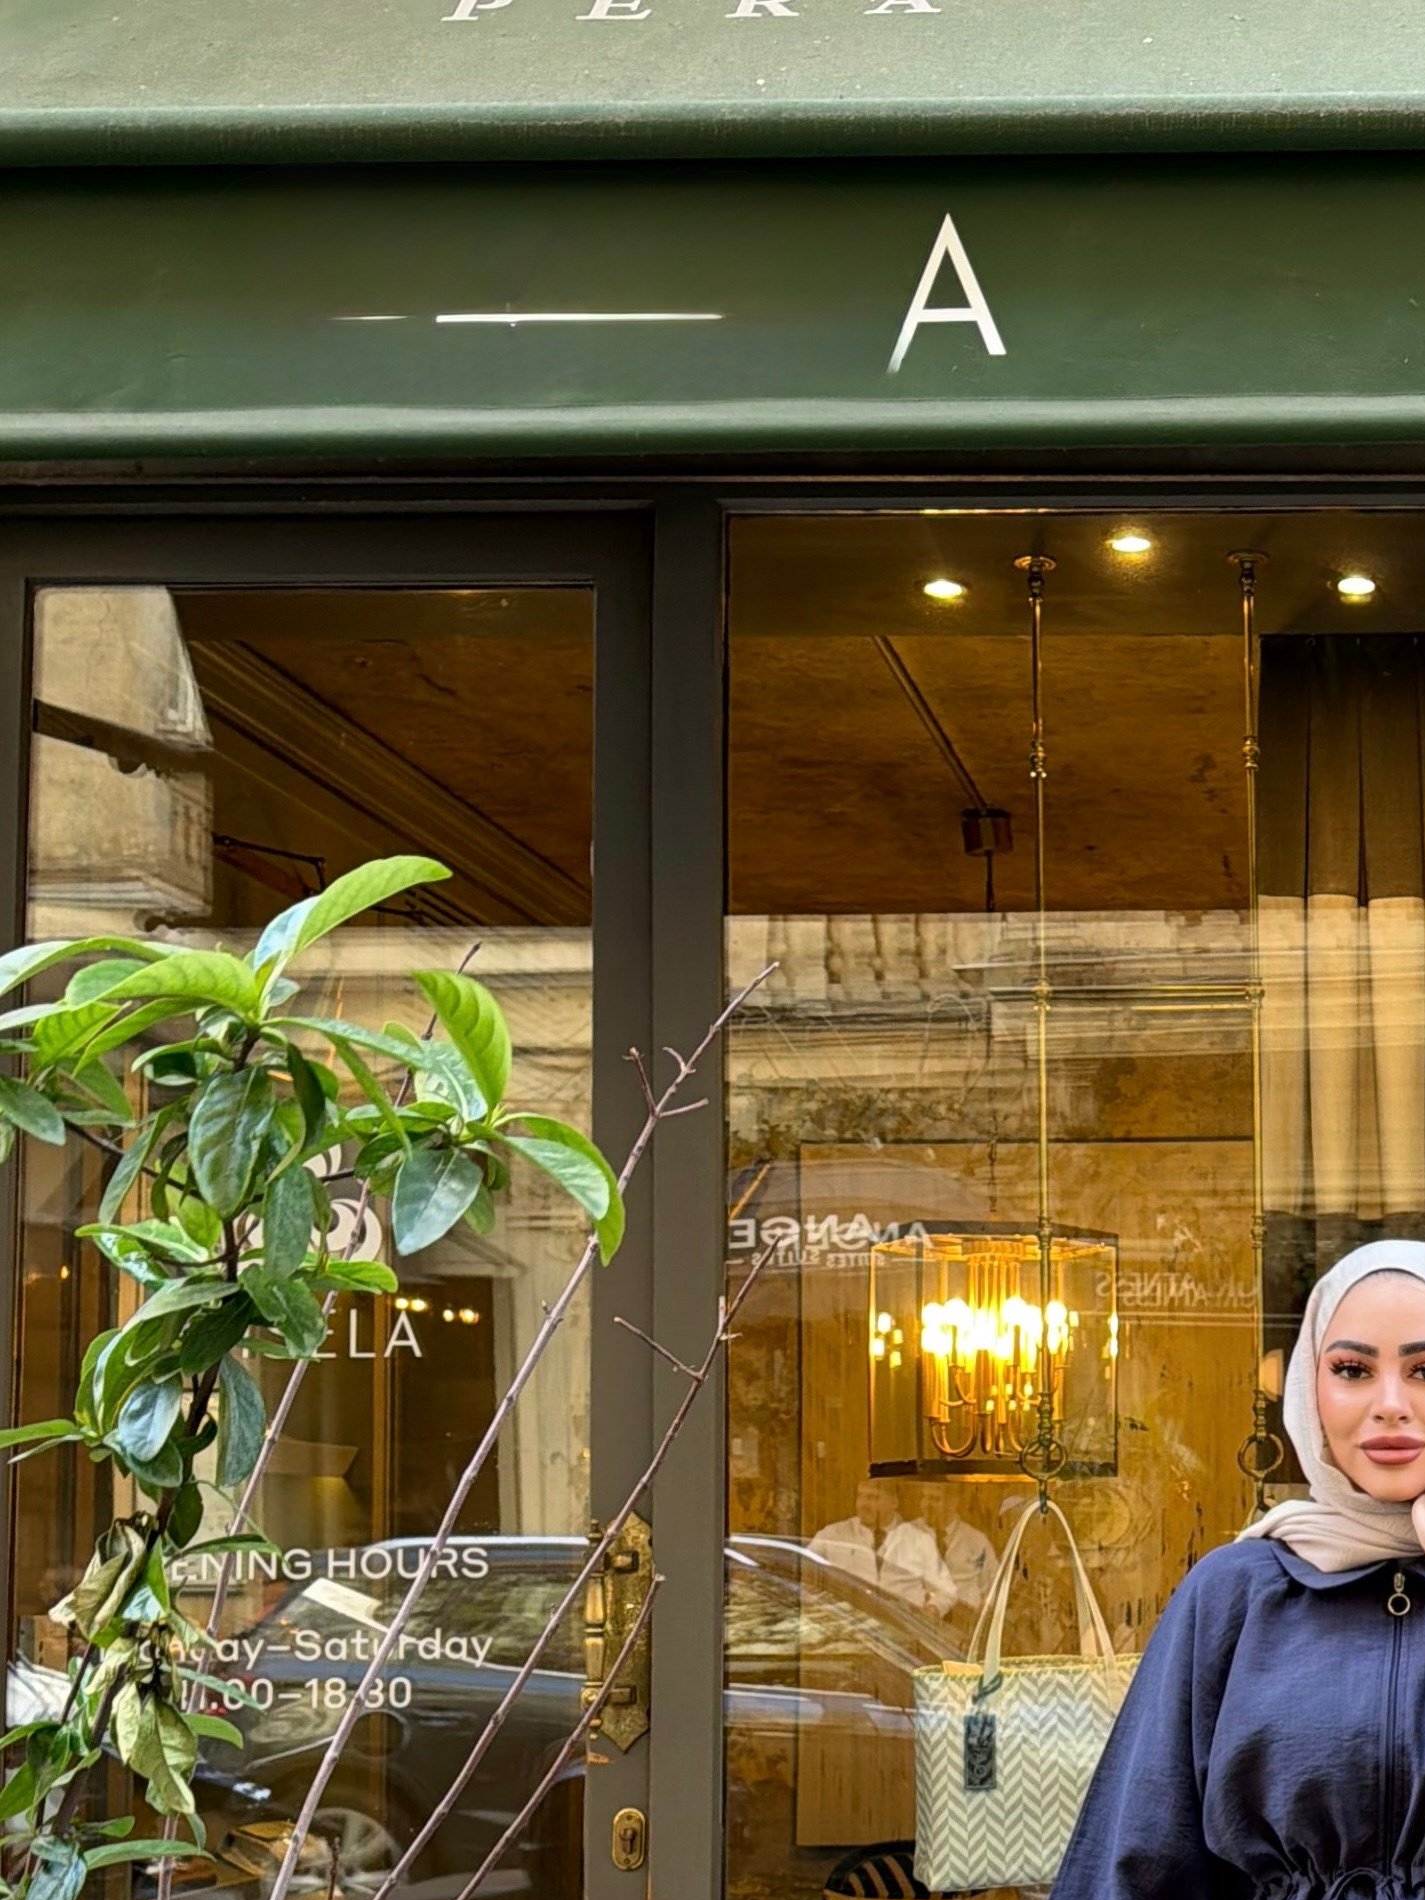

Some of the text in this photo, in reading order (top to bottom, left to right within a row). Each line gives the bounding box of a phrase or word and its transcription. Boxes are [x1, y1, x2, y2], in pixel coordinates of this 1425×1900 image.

[886, 212, 1006, 374] A
[171, 1546, 490, 1580] ENING HOURS
